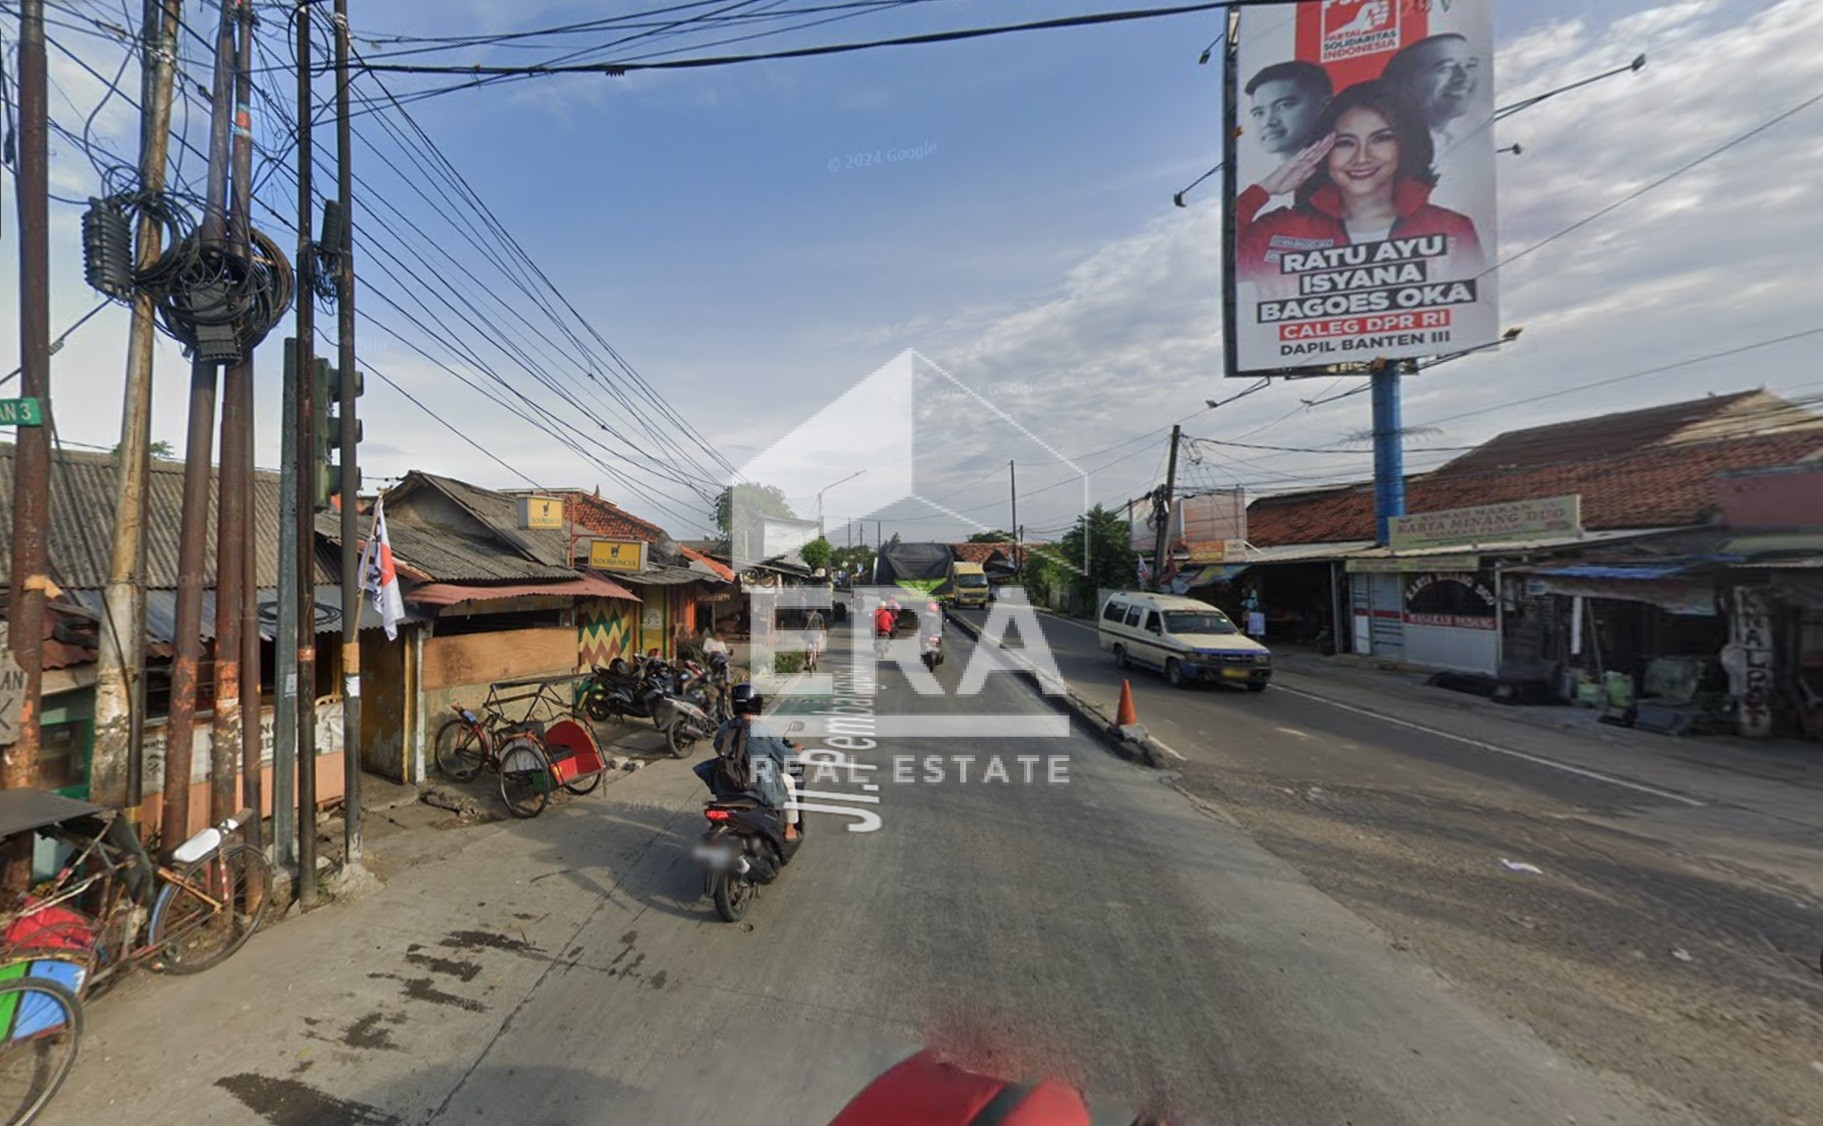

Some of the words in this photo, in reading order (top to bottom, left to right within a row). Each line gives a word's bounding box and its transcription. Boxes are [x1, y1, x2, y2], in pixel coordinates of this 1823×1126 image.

[1323, 30, 1397, 51] SOLIDARITAS
[1323, 40, 1397, 60] INDONESIA
[1283, 243, 1367, 273] RATU
[1373, 236, 1444, 262] AYU
[1302, 263, 1424, 294] ISYANA
[1260, 291, 1390, 321] BAGOES
[1396, 283, 1473, 308] OKA
[1283, 319, 1361, 339] CALEG
[1367, 313, 1416, 331] DPR
[1422, 310, 1447, 327] RI
[1280, 341, 1336, 356] DAPIL
[1341, 333, 1425, 351] BANTEN
[1431, 330, 1451, 343] III
[20, 402, 32, 421] 3
[1397, 520, 1445, 535] KARYA
[1450, 513, 1518, 528] MINANG
[1526, 507, 1565, 521] DUO
[1474, 503, 1534, 517] MAKAN
